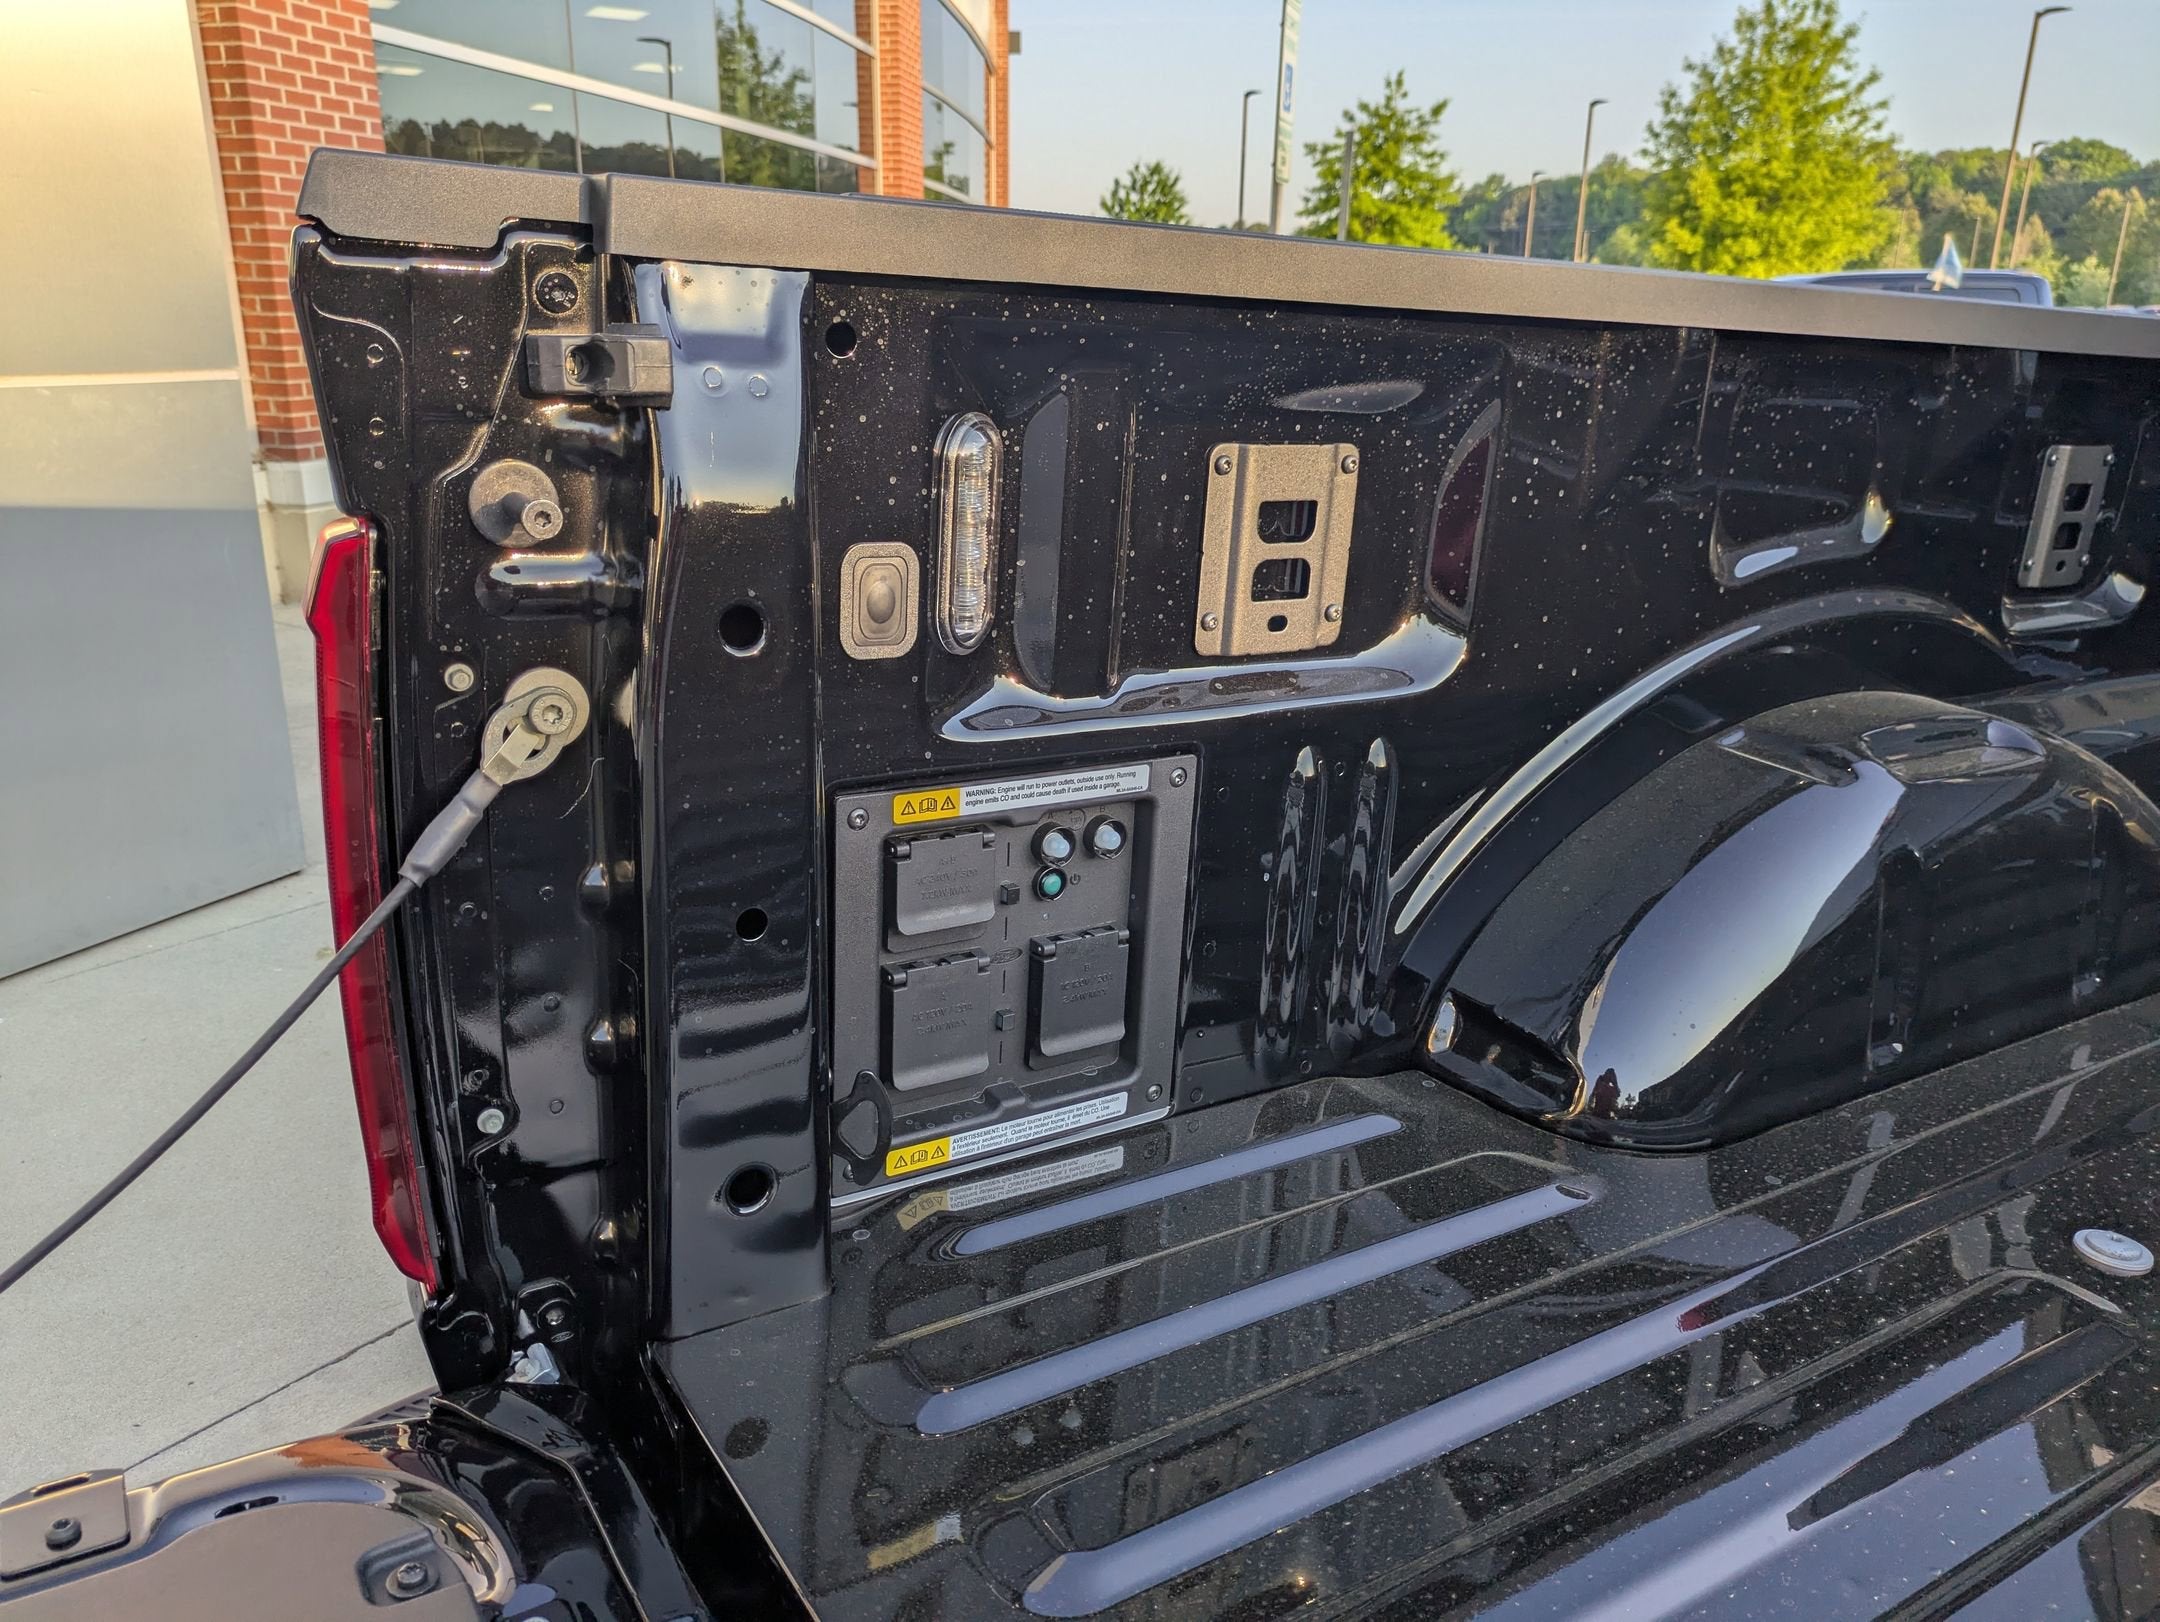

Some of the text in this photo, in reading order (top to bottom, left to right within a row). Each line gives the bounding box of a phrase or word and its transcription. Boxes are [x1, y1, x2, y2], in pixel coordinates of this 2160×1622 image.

[965, 788, 996, 797] WARNING:
[998, 786, 1016, 794] Engine
[1042, 781, 1058, 789] power
[1077, 776, 1094, 784] outside
[965, 799, 984, 807] engine
[1000, 794, 1009, 802] CO
[1084, 783, 1098, 791] inside
[952, 1127, 1000, 1144] AVERTISSEMENT:
[1009, 1121, 1026, 1129] moteur
[1043, 1114, 1054, 1122] pour
[1054, 1108, 1075, 1117] alimenter
[1098, 1097, 1120, 1105] Utilisation
[1011, 1126, 1027, 1135] Quand
[1015, 1132, 1032, 1142] garage
[1032, 1129, 1043, 1137] peut
